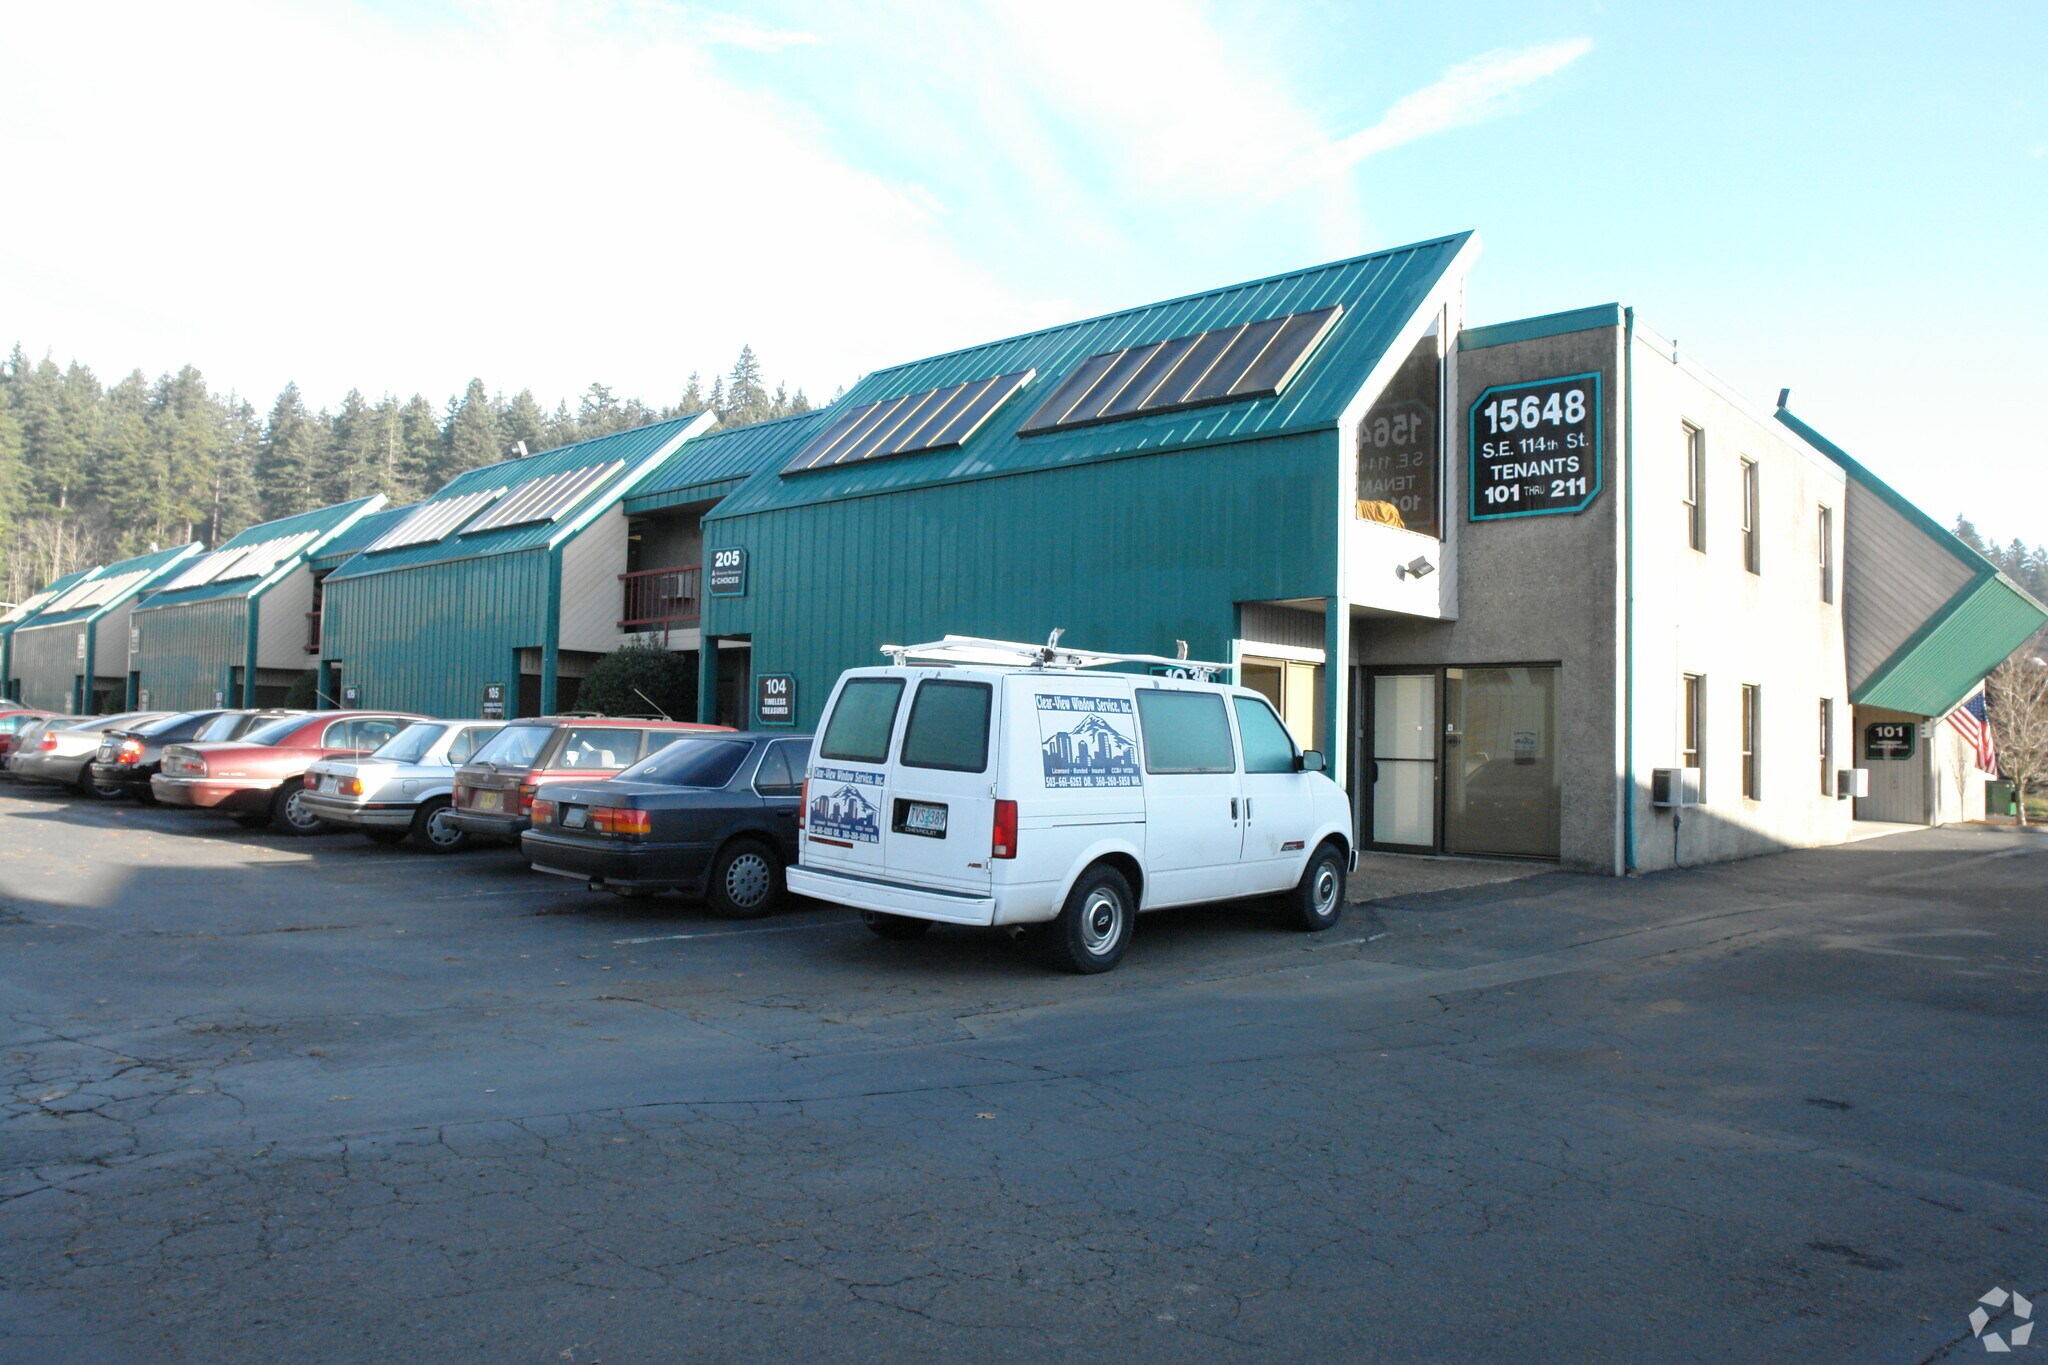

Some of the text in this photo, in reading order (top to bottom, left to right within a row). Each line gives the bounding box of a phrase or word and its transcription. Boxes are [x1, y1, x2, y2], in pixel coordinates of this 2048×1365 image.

[1484, 389, 1586, 434] 15648
[1482, 432, 1589, 458] S.E. 114th St.
[1491, 455, 1579, 481] TENANTS
[1484, 477, 1586, 503] 101 THRU 211
[715, 550, 740, 567] 205
[488, 687, 499, 699] 105
[766, 679, 787, 694] 104
[761, 706, 788, 715] TREASURES
[764, 698, 786, 706] TIMELESS
[1036, 695, 1070, 710] Clear-View
[1071, 697, 1094, 711] Window
[1120, 699, 1132, 713] Inc.
[1875, 726, 1903, 738] 101
